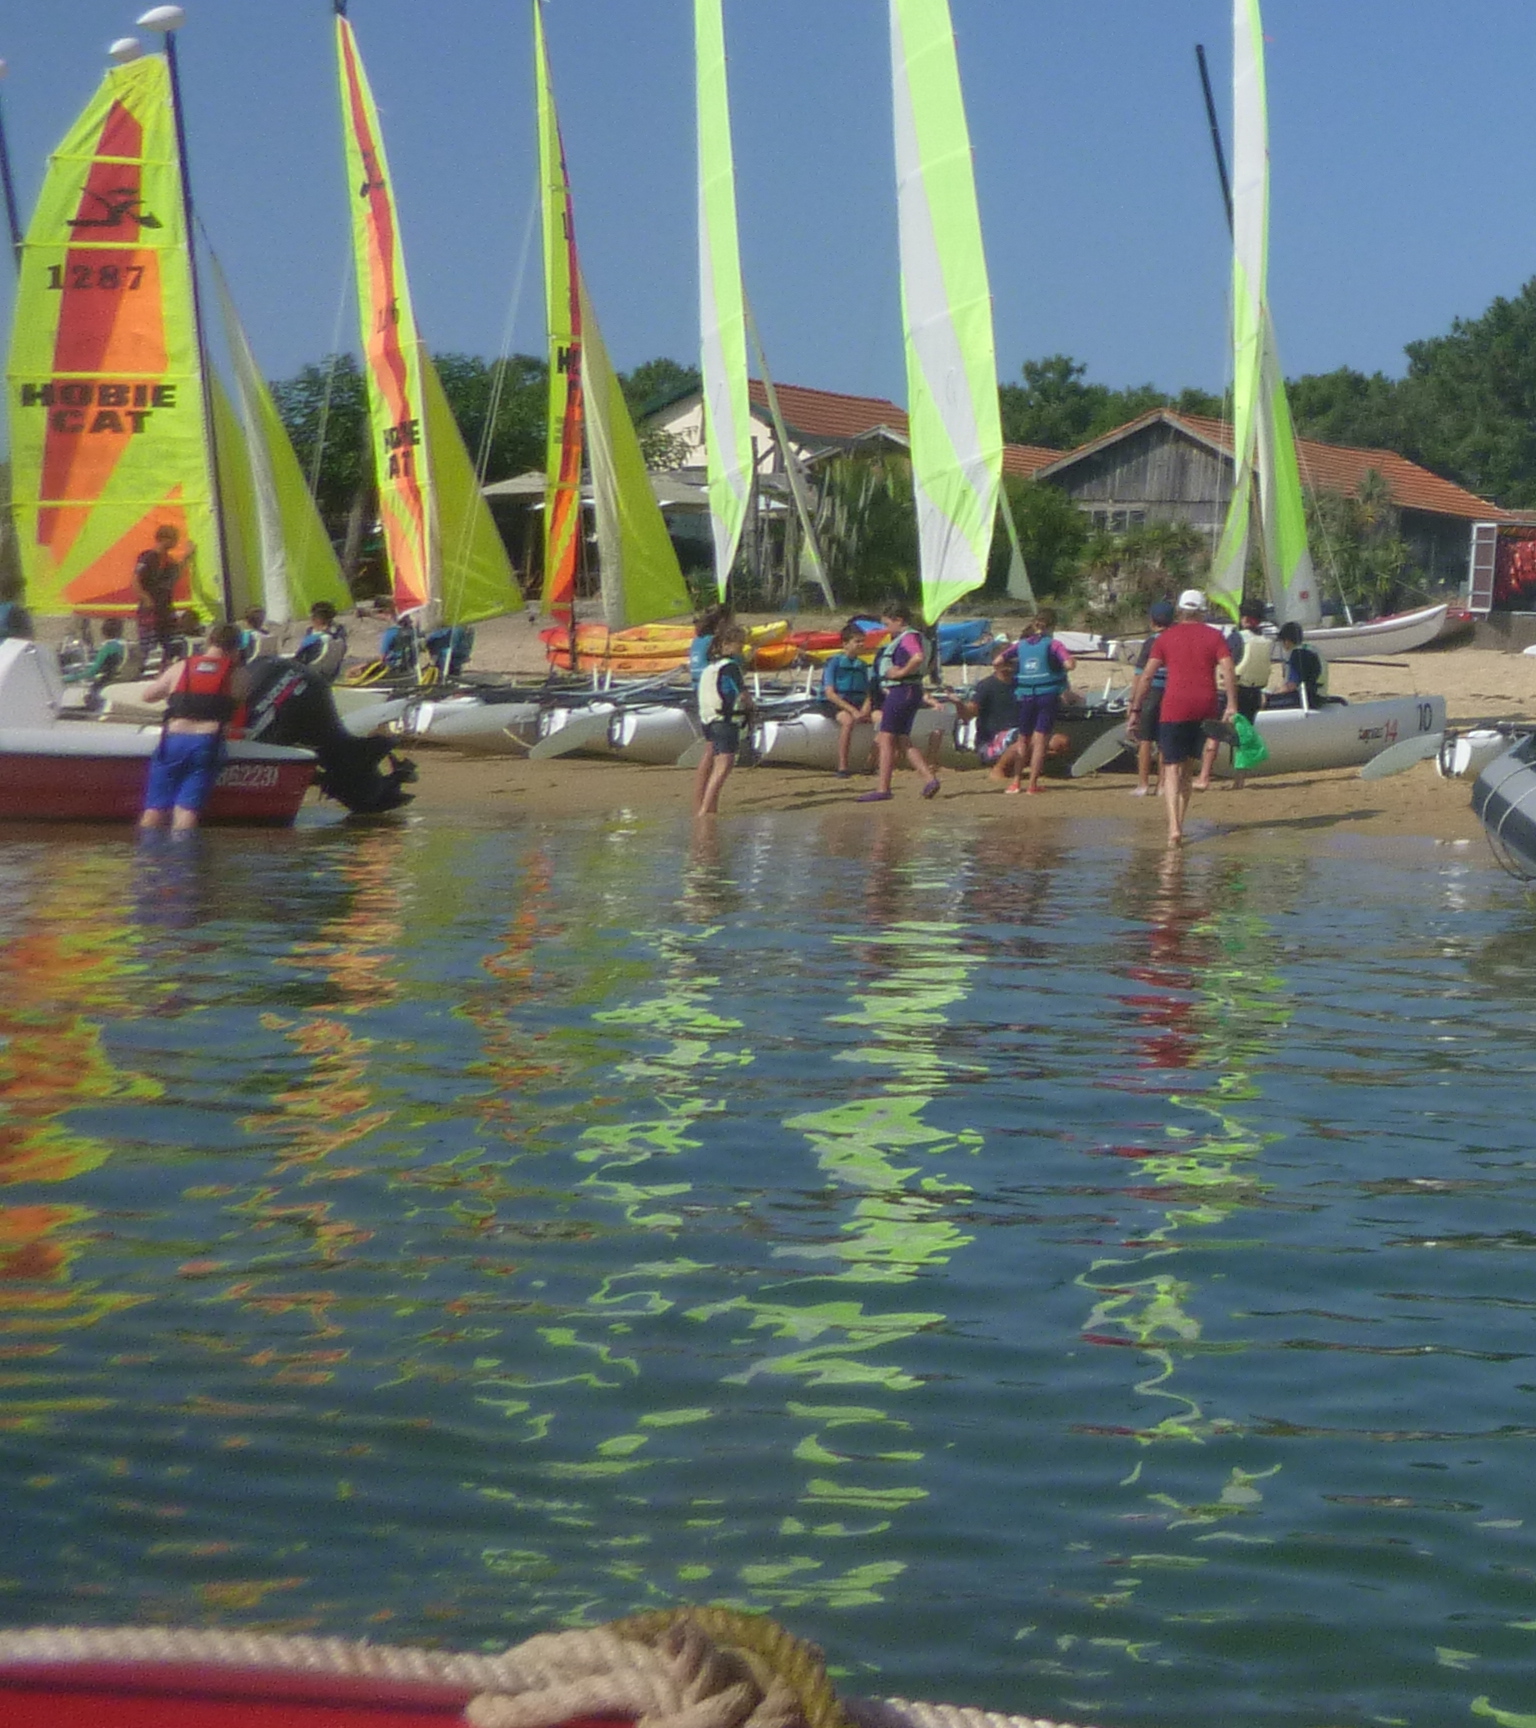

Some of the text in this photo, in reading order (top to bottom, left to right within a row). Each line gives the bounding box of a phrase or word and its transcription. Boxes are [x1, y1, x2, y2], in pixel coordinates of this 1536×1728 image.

[47, 263, 145, 290] 1287
[20, 383, 177, 408] HOBIE
[52, 409, 153, 434] CAT
[1417, 702, 1432, 732] 10
